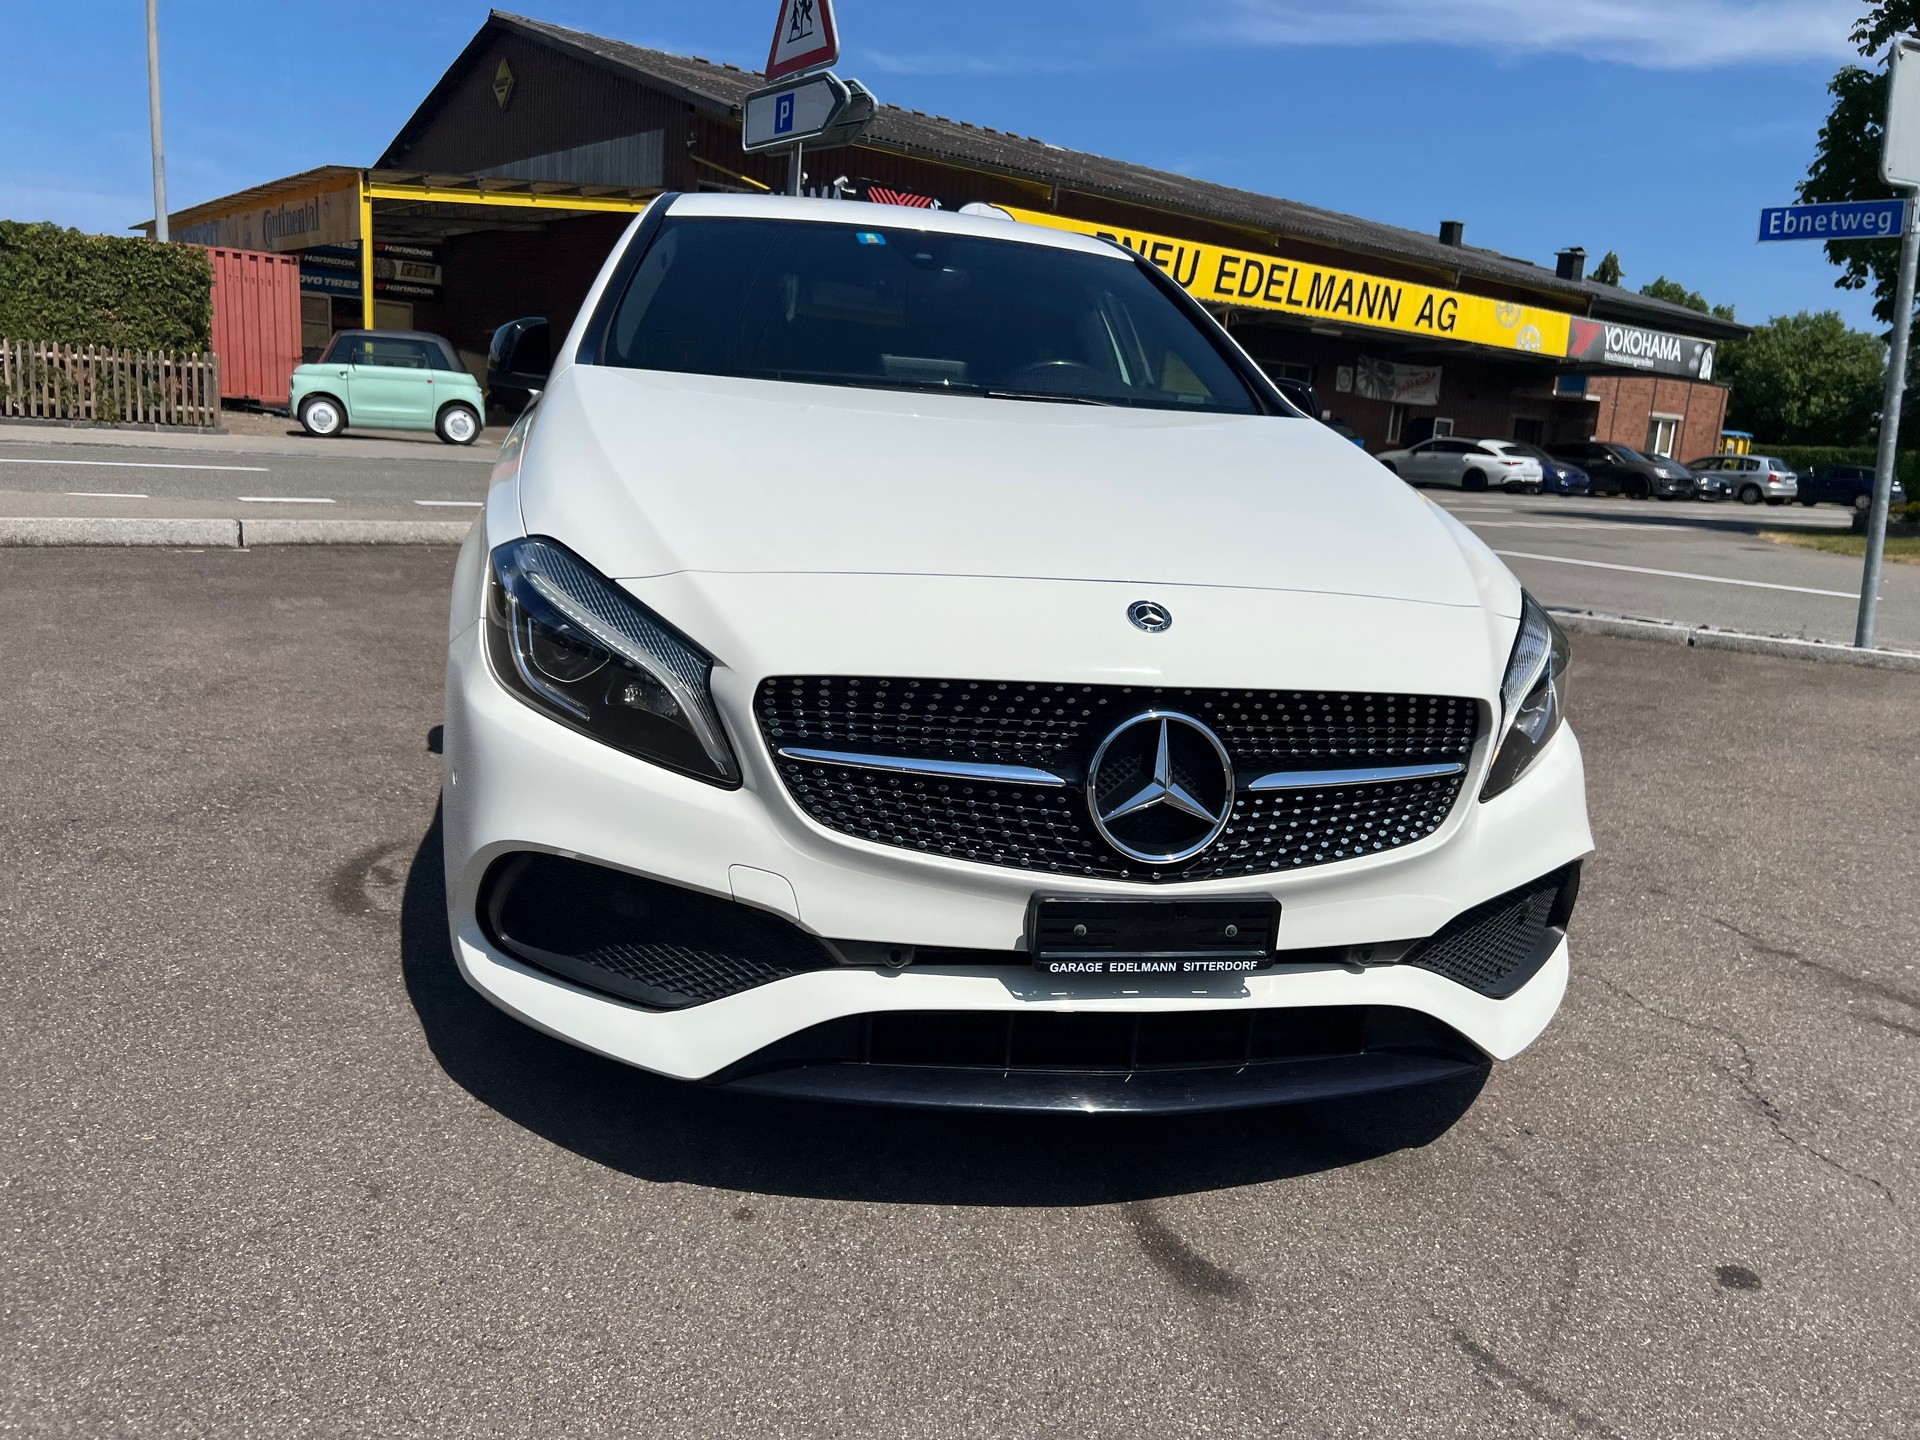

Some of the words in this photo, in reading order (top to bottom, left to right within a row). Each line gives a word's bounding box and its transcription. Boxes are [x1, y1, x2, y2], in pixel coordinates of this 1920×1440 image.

[779, 100, 790, 129] P
[262, 196, 320, 246] Continental
[1769, 210, 1892, 235] Ebnetweg
[299, 275, 324, 286] OYO
[324, 277, 360, 290] TIRES
[1096, 231, 1201, 289] EU
[1213, 254, 1402, 322] EDELMANN
[1414, 294, 1459, 333] AG
[1604, 325, 1682, 363] YOKOHAMA
[1049, 962, 1103, 973] GARAGE
[1109, 962, 1177, 972] EDELMANN
[1183, 961, 1258, 972] SITTERDORF
